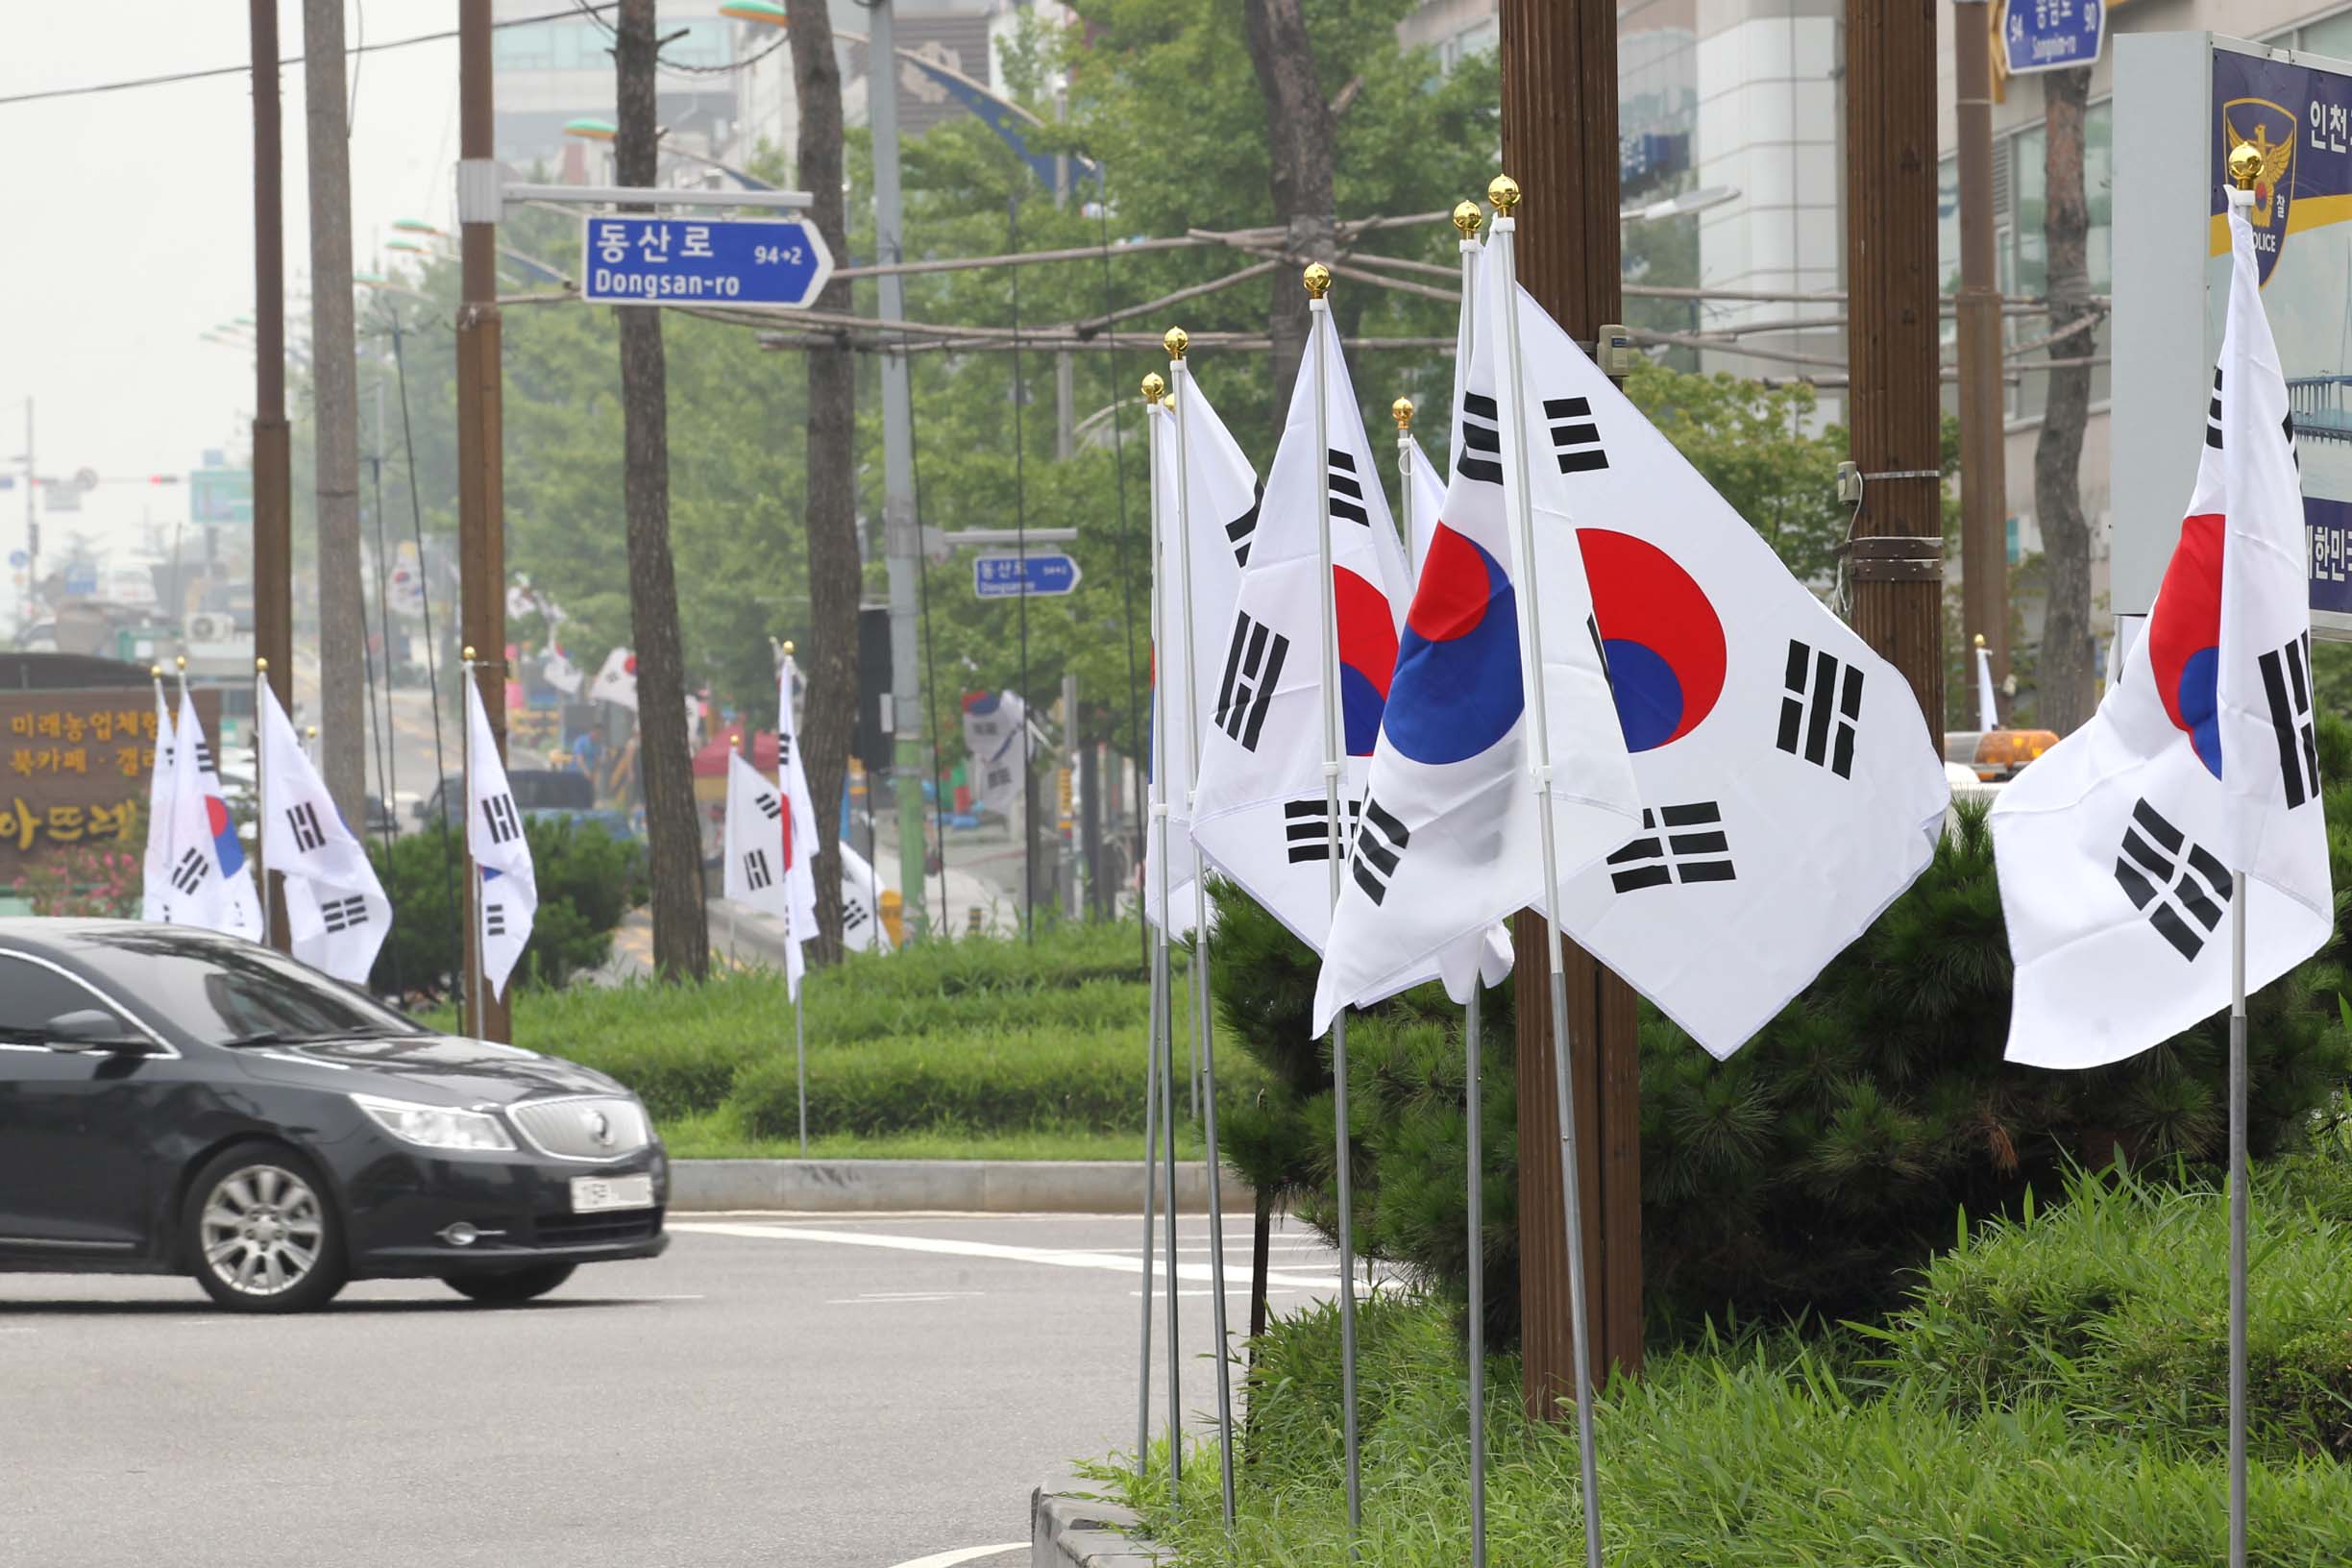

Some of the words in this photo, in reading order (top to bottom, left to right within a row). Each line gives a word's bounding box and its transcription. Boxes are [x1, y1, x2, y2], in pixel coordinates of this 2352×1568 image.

[2310, 100, 2352, 154] 인천
[596, 223, 714, 264] 동산로
[2252, 233, 2276, 253] OLICE
[595, 268, 741, 299] Dongsan-ro
[2306, 525, 2352, 582] 한민
